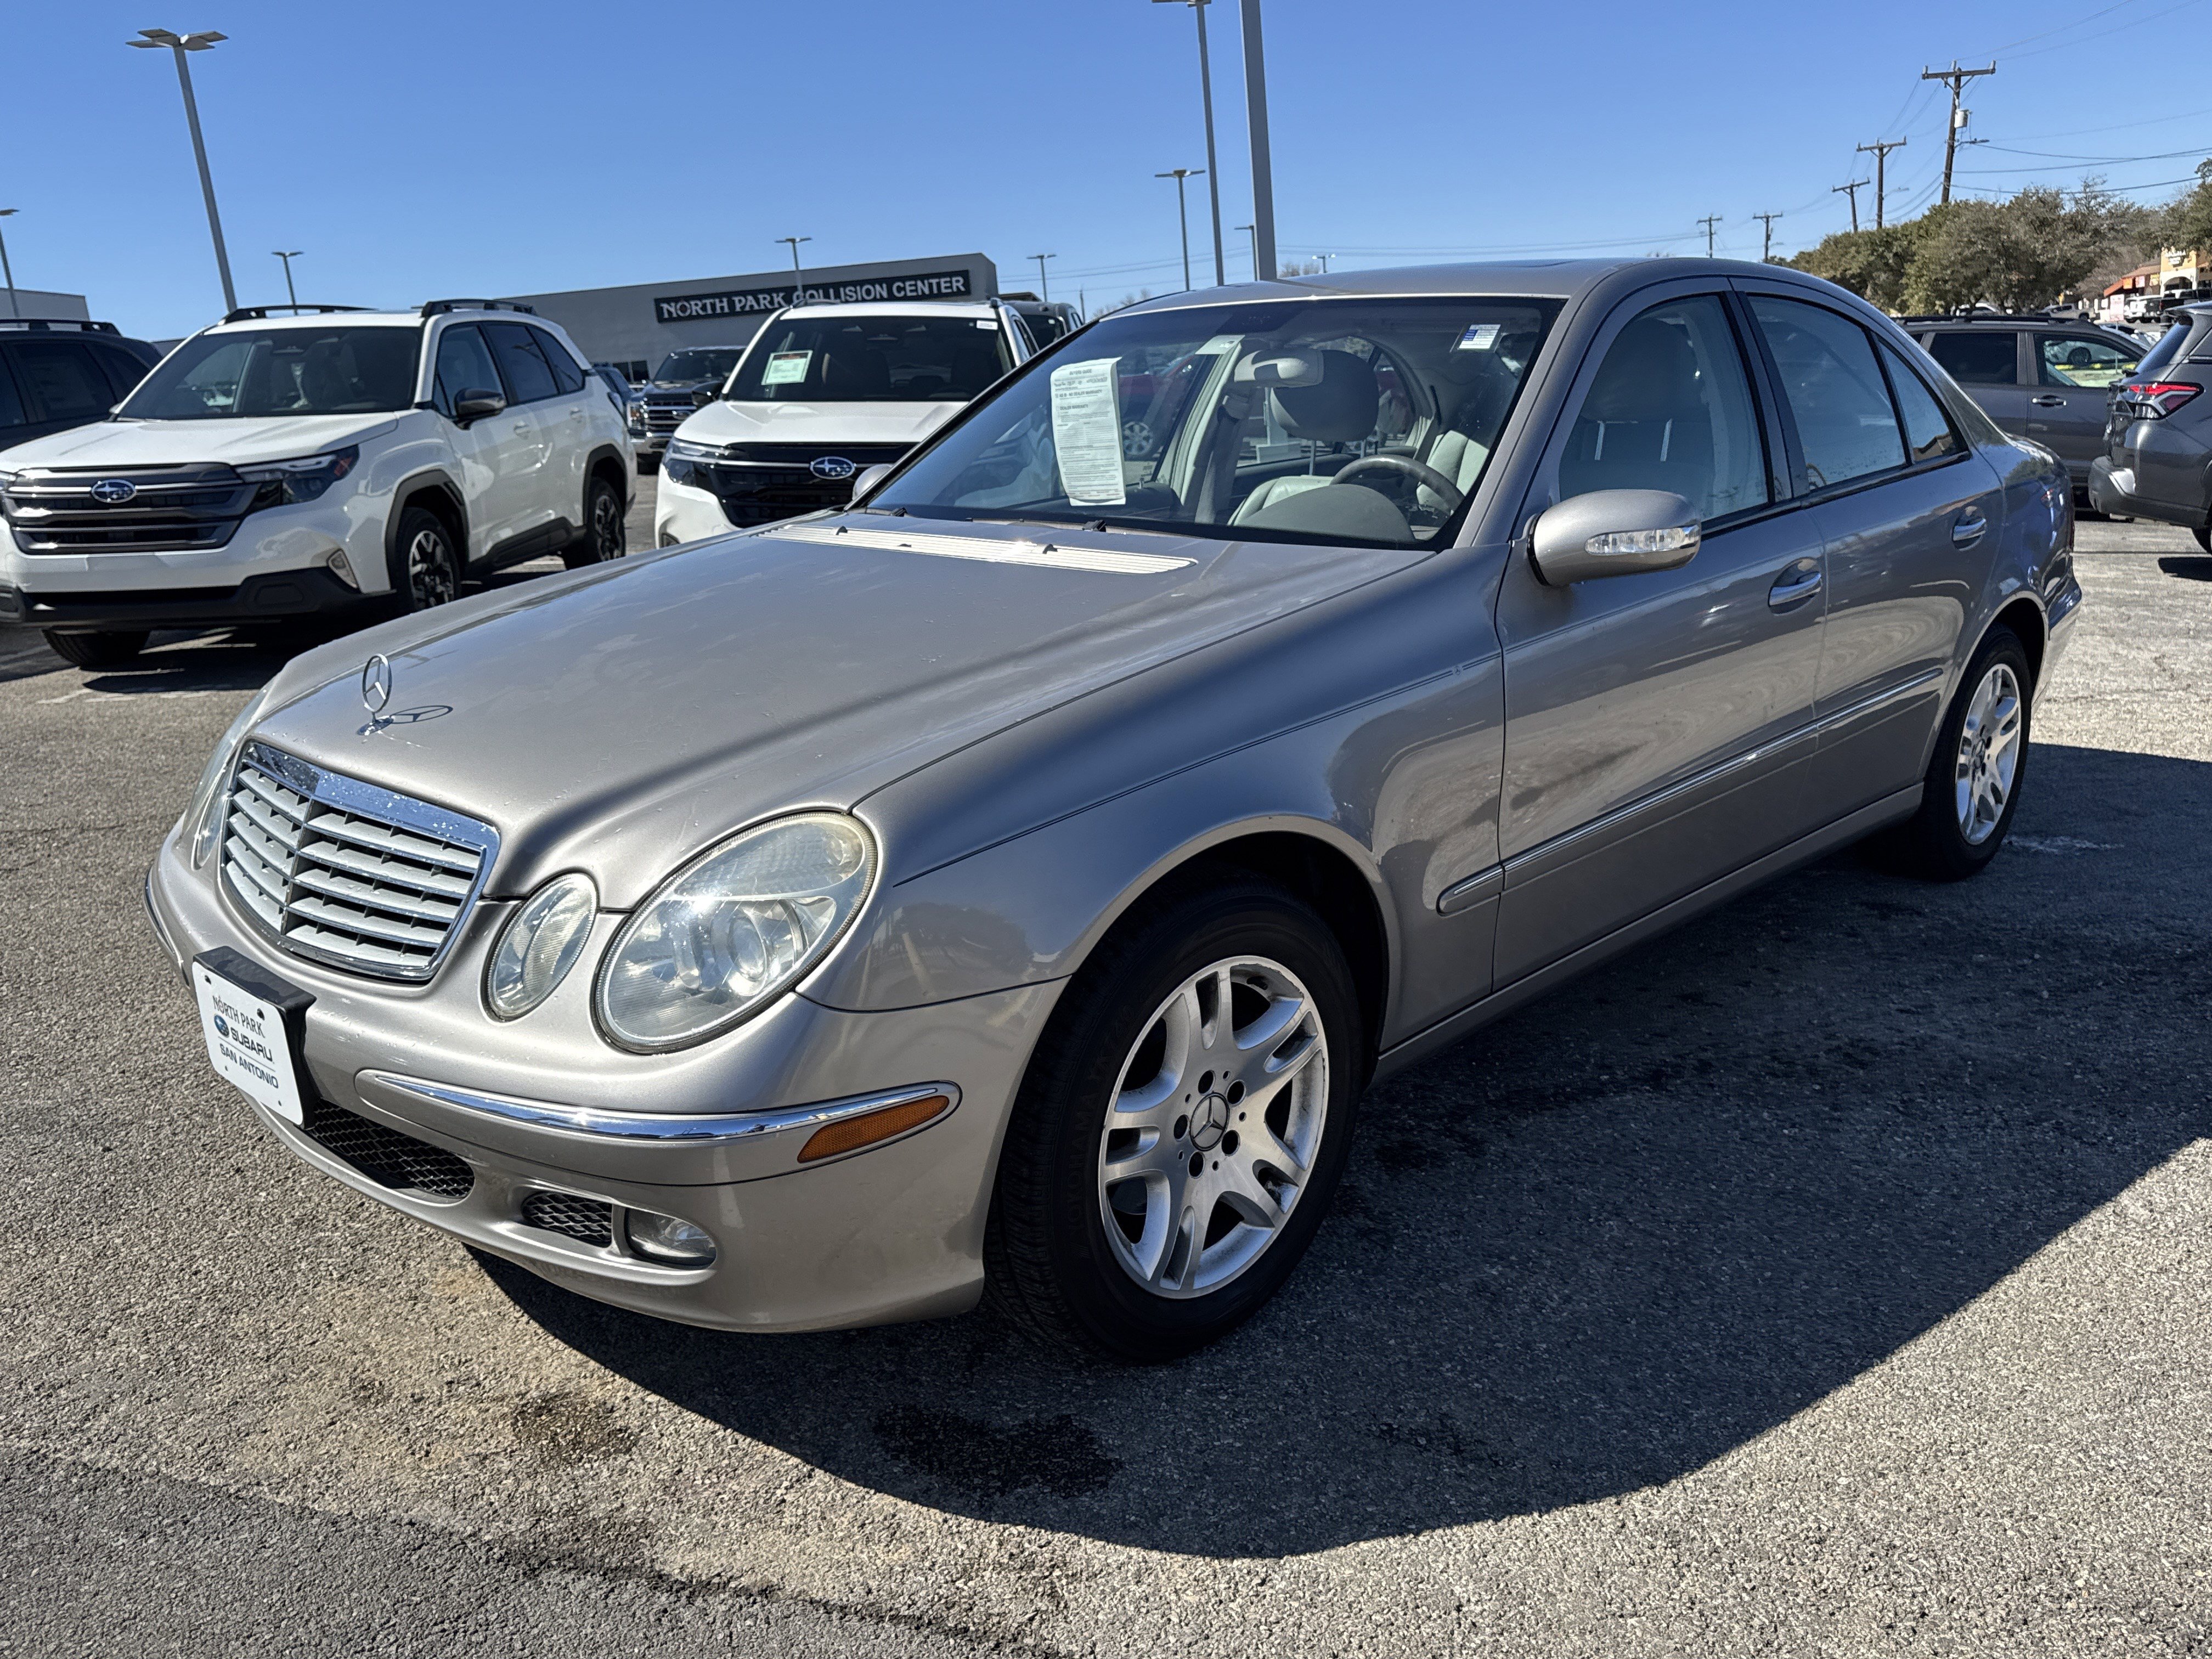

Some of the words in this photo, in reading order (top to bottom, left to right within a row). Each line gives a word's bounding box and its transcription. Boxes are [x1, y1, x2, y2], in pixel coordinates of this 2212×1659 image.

[661, 297, 730, 319] NORTH
[731, 292, 789, 312] PARK
[793, 283, 888, 303] COLLISION
[892, 276, 966, 297] CENTER
[212, 995, 240, 1024] NORTH
[240, 1012, 266, 1038] PARK
[230, 1026, 273, 1062] SUBARU
[219, 1043, 238, 1064] SAN
[239, 1056, 279, 1089] ANTONIO
[1068, 1093, 1098, 1235] YOKOHAMA
